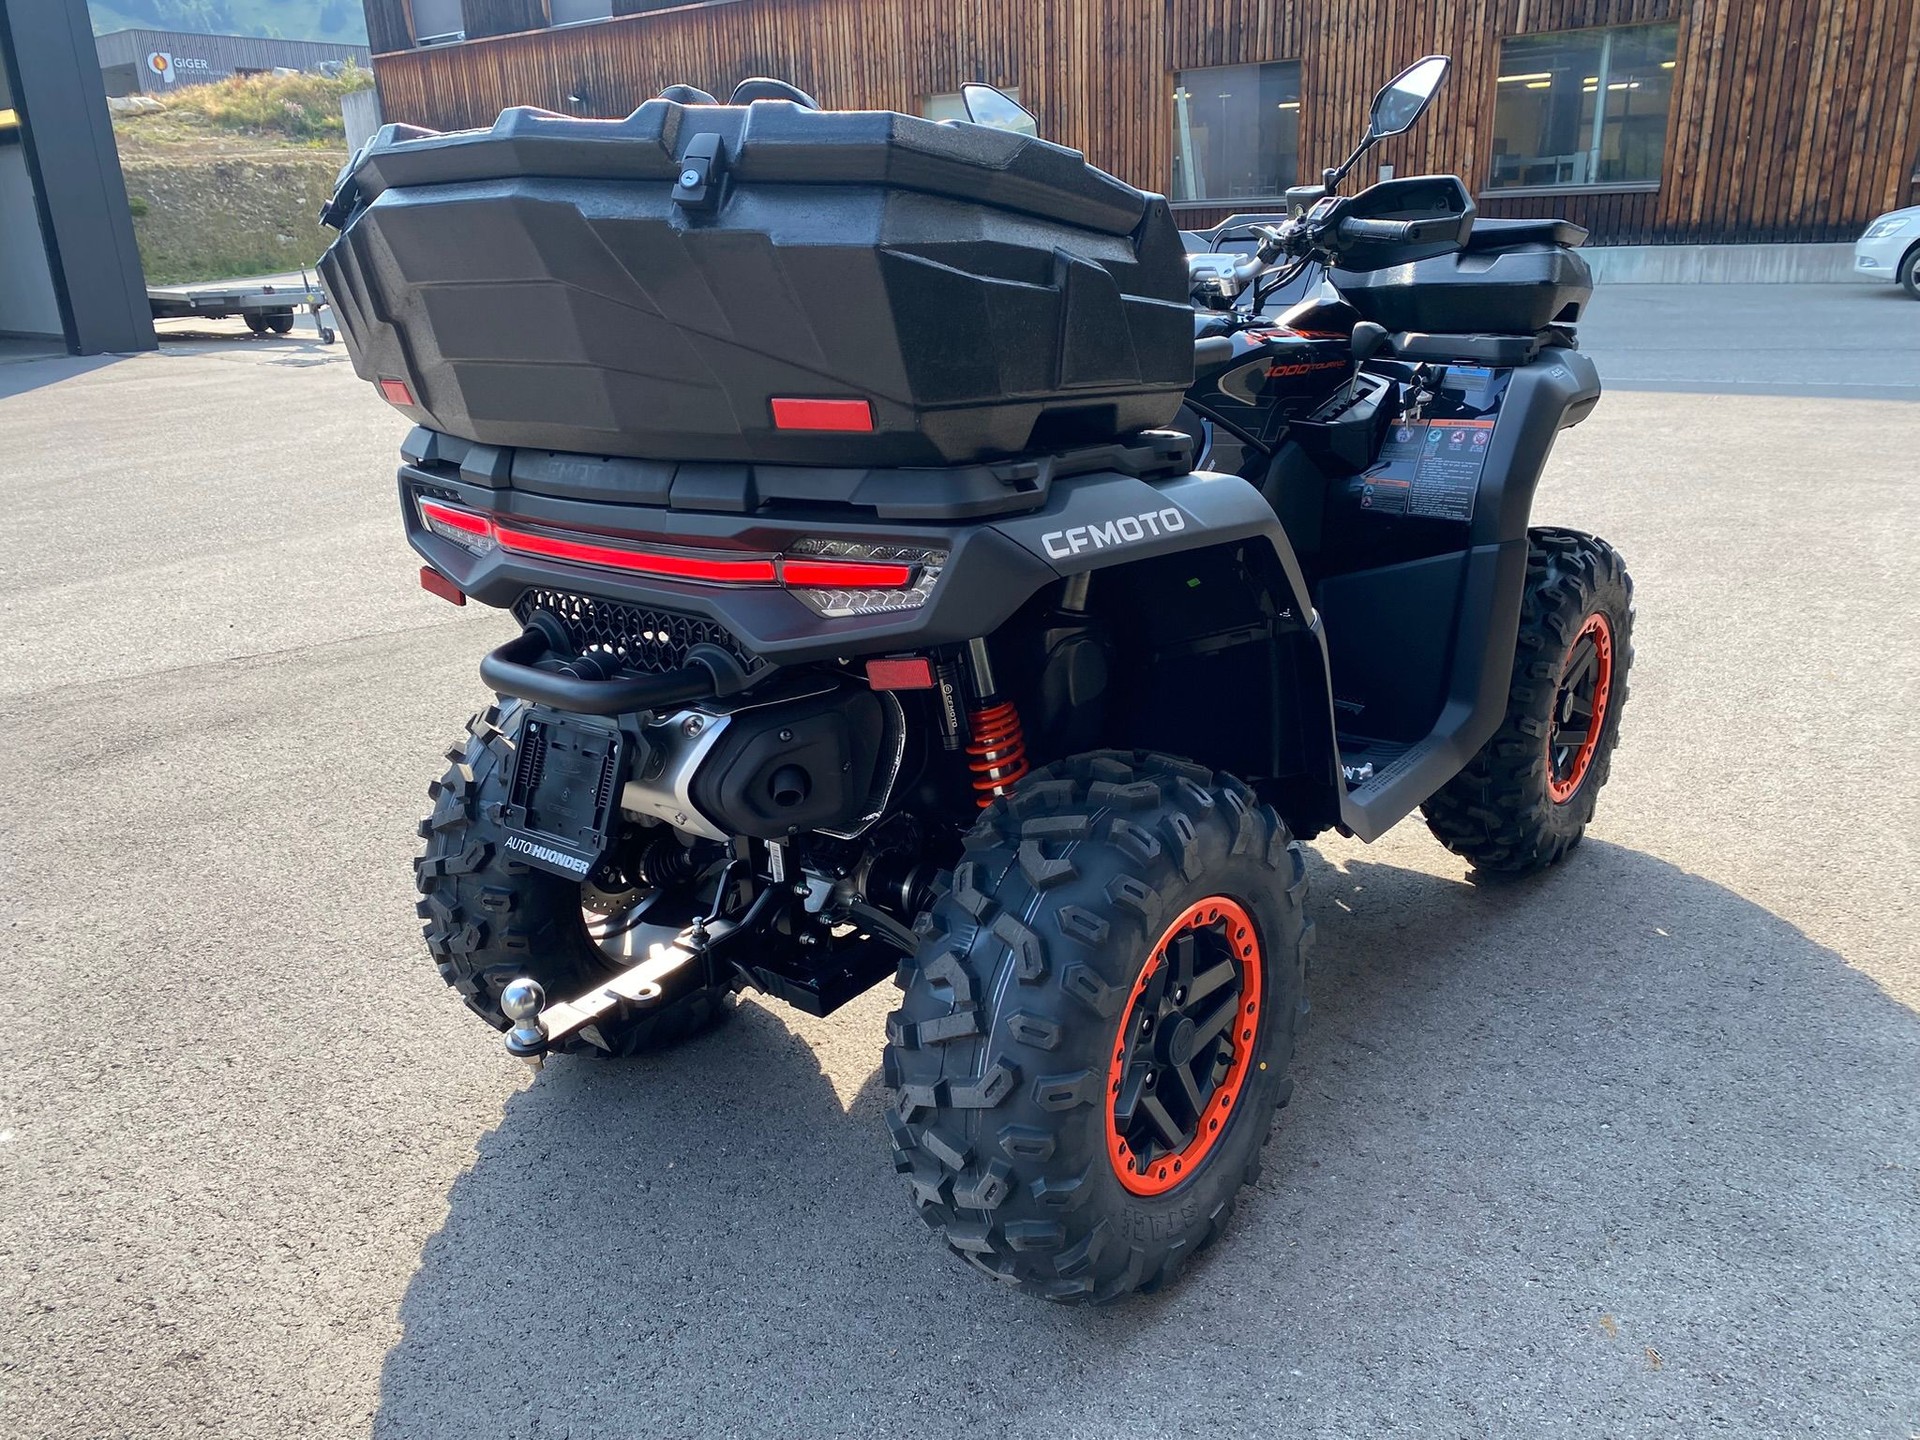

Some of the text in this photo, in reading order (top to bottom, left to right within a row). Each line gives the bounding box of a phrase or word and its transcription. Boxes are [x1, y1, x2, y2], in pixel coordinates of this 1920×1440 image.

[173, 57, 208, 69] GIGER
[1263, 364, 1310, 377] 1000
[1041, 507, 1185, 560] CFMOTO
[503, 835, 590, 875] AUTO HUONDER
